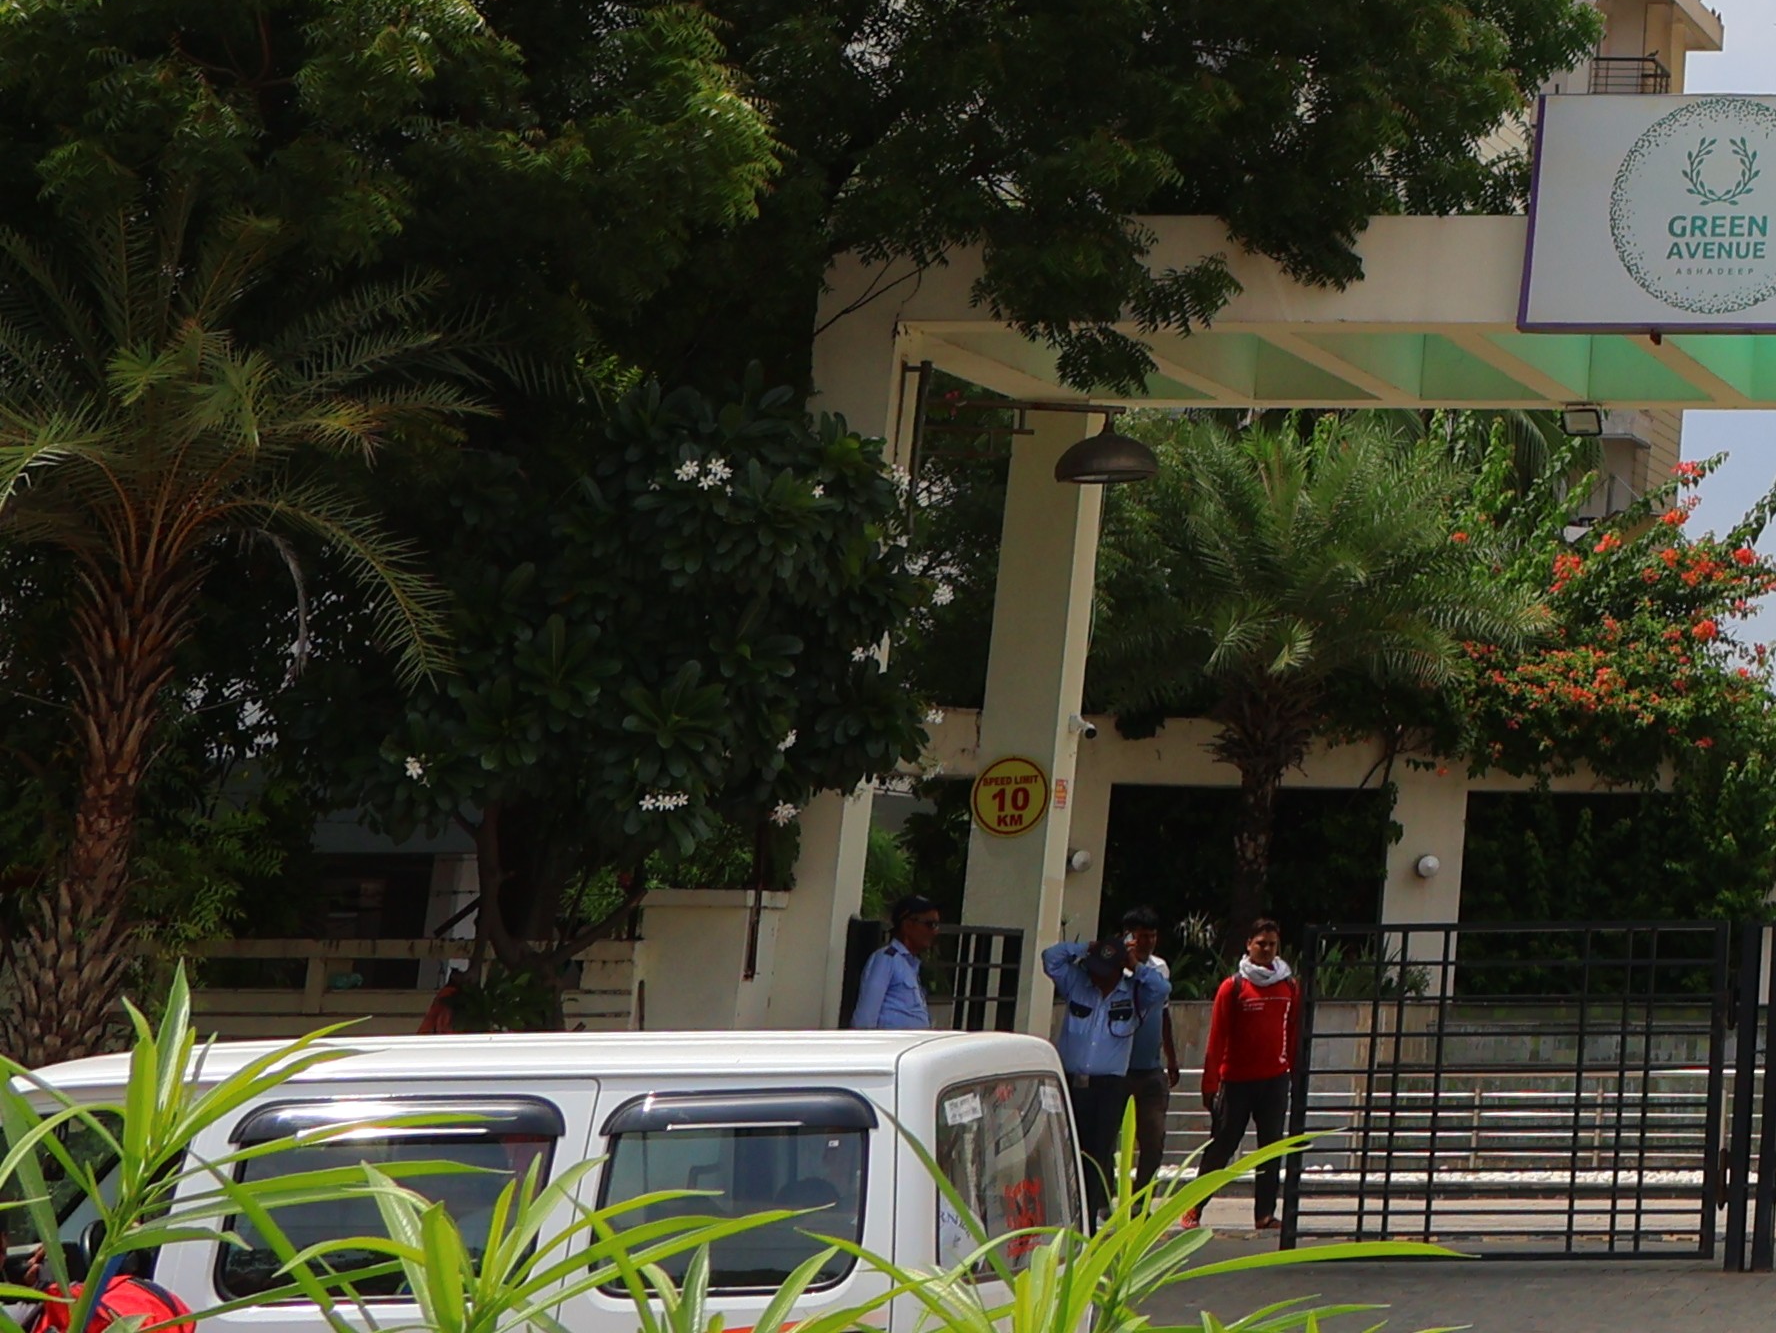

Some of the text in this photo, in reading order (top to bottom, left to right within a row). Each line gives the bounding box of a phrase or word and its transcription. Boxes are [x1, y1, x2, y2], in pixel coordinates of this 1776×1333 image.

[1667, 215, 1768, 238] GREEN
[1666, 241, 1766, 260] AVENUE
[1675, 267, 1755, 276] ASHADEEP
[983, 775, 1039, 786] SPEED LIMIT
[992, 787, 1030, 812] 10
[997, 814, 1023, 826] KM
